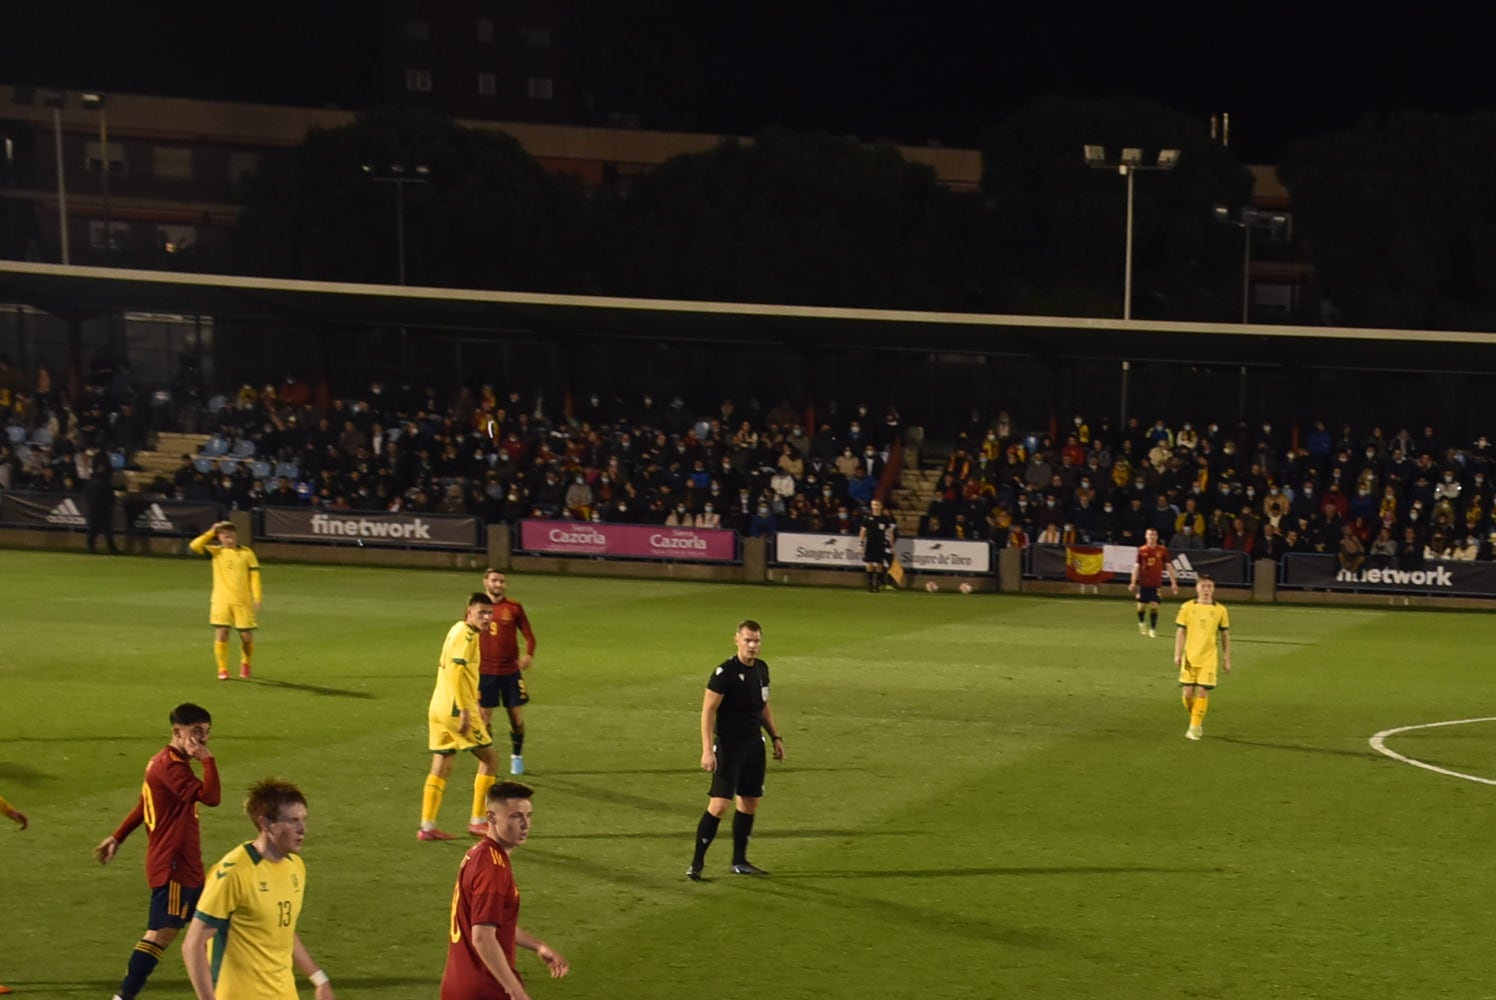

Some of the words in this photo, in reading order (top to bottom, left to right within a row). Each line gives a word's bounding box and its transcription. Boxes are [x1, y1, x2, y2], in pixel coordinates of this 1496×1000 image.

[311, 513, 432, 540] finetwork
[549, 529, 606, 545] Cazorla
[650, 533, 708, 550] Cazorla
[277, 900, 292, 928] 13
